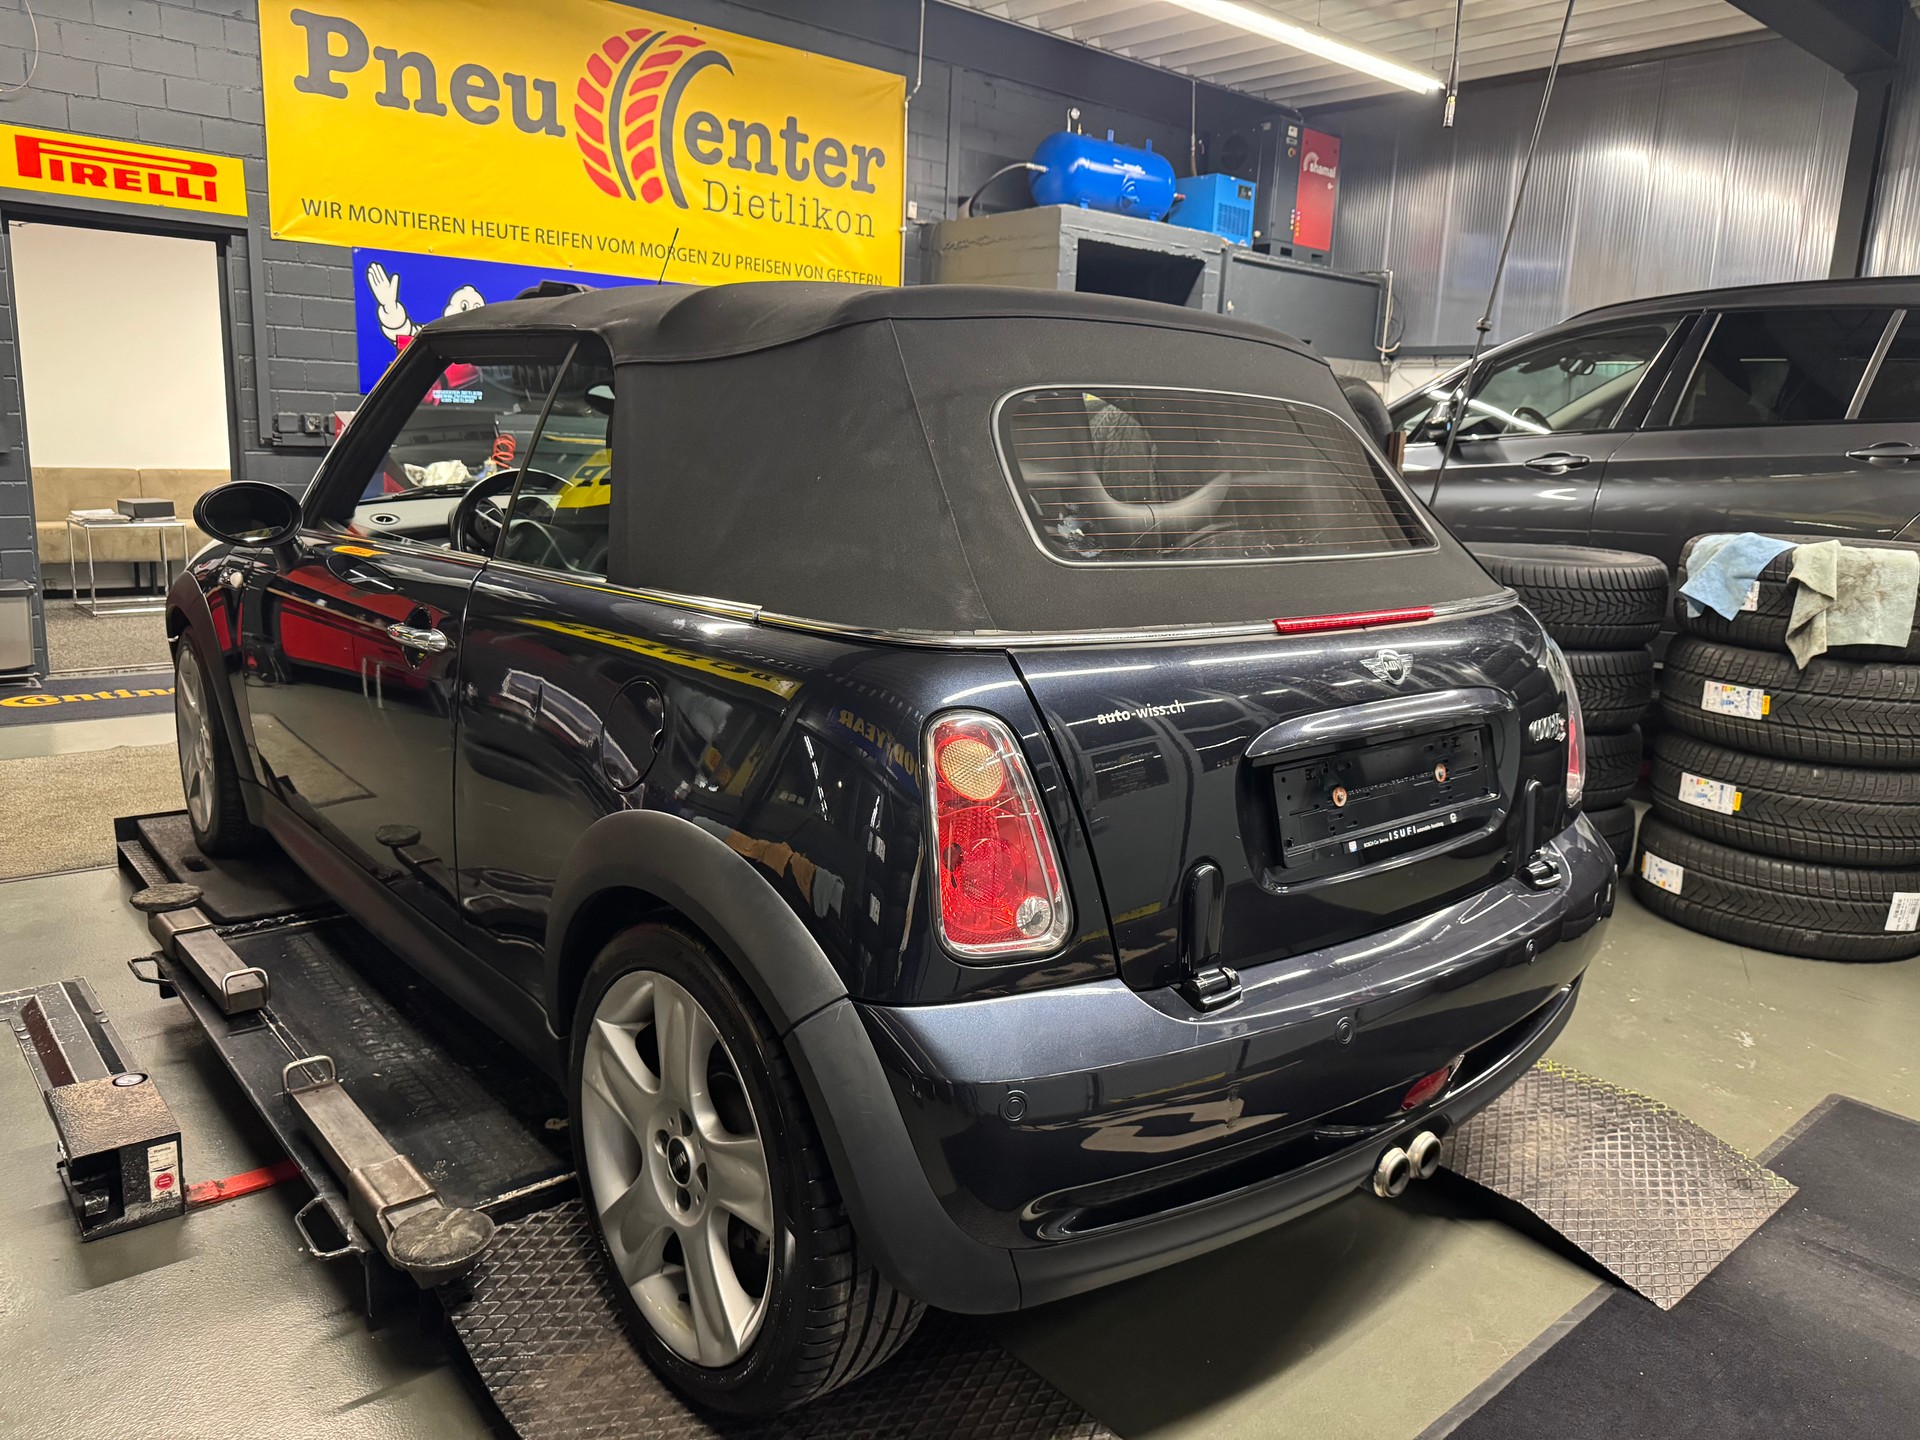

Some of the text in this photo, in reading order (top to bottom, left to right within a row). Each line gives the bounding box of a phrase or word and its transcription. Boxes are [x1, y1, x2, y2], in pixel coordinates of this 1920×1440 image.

[289, 7, 566, 138] Pneu
[14, 134, 218, 203] PIRELLI
[702, 178, 875, 238] Dietlikon
[301, 197, 343, 220] WIR
[349, 203, 466, 235] MONTIEREN
[471, 219, 530, 243] HEUTE
[535, 227, 594, 250] REIFEN
[597, 235, 635, 256] VOM
[639, 242, 708, 266] MORGEN
[711, 251, 732, 268] ZU
[735, 255, 792, 277] PREISEN
[794, 263, 824, 280] VON
[0, 688, 175, 708] Contin
[1097, 699, 1186, 725] auto-wiss.ch
[1388, 825, 1417, 841] ISUFI
